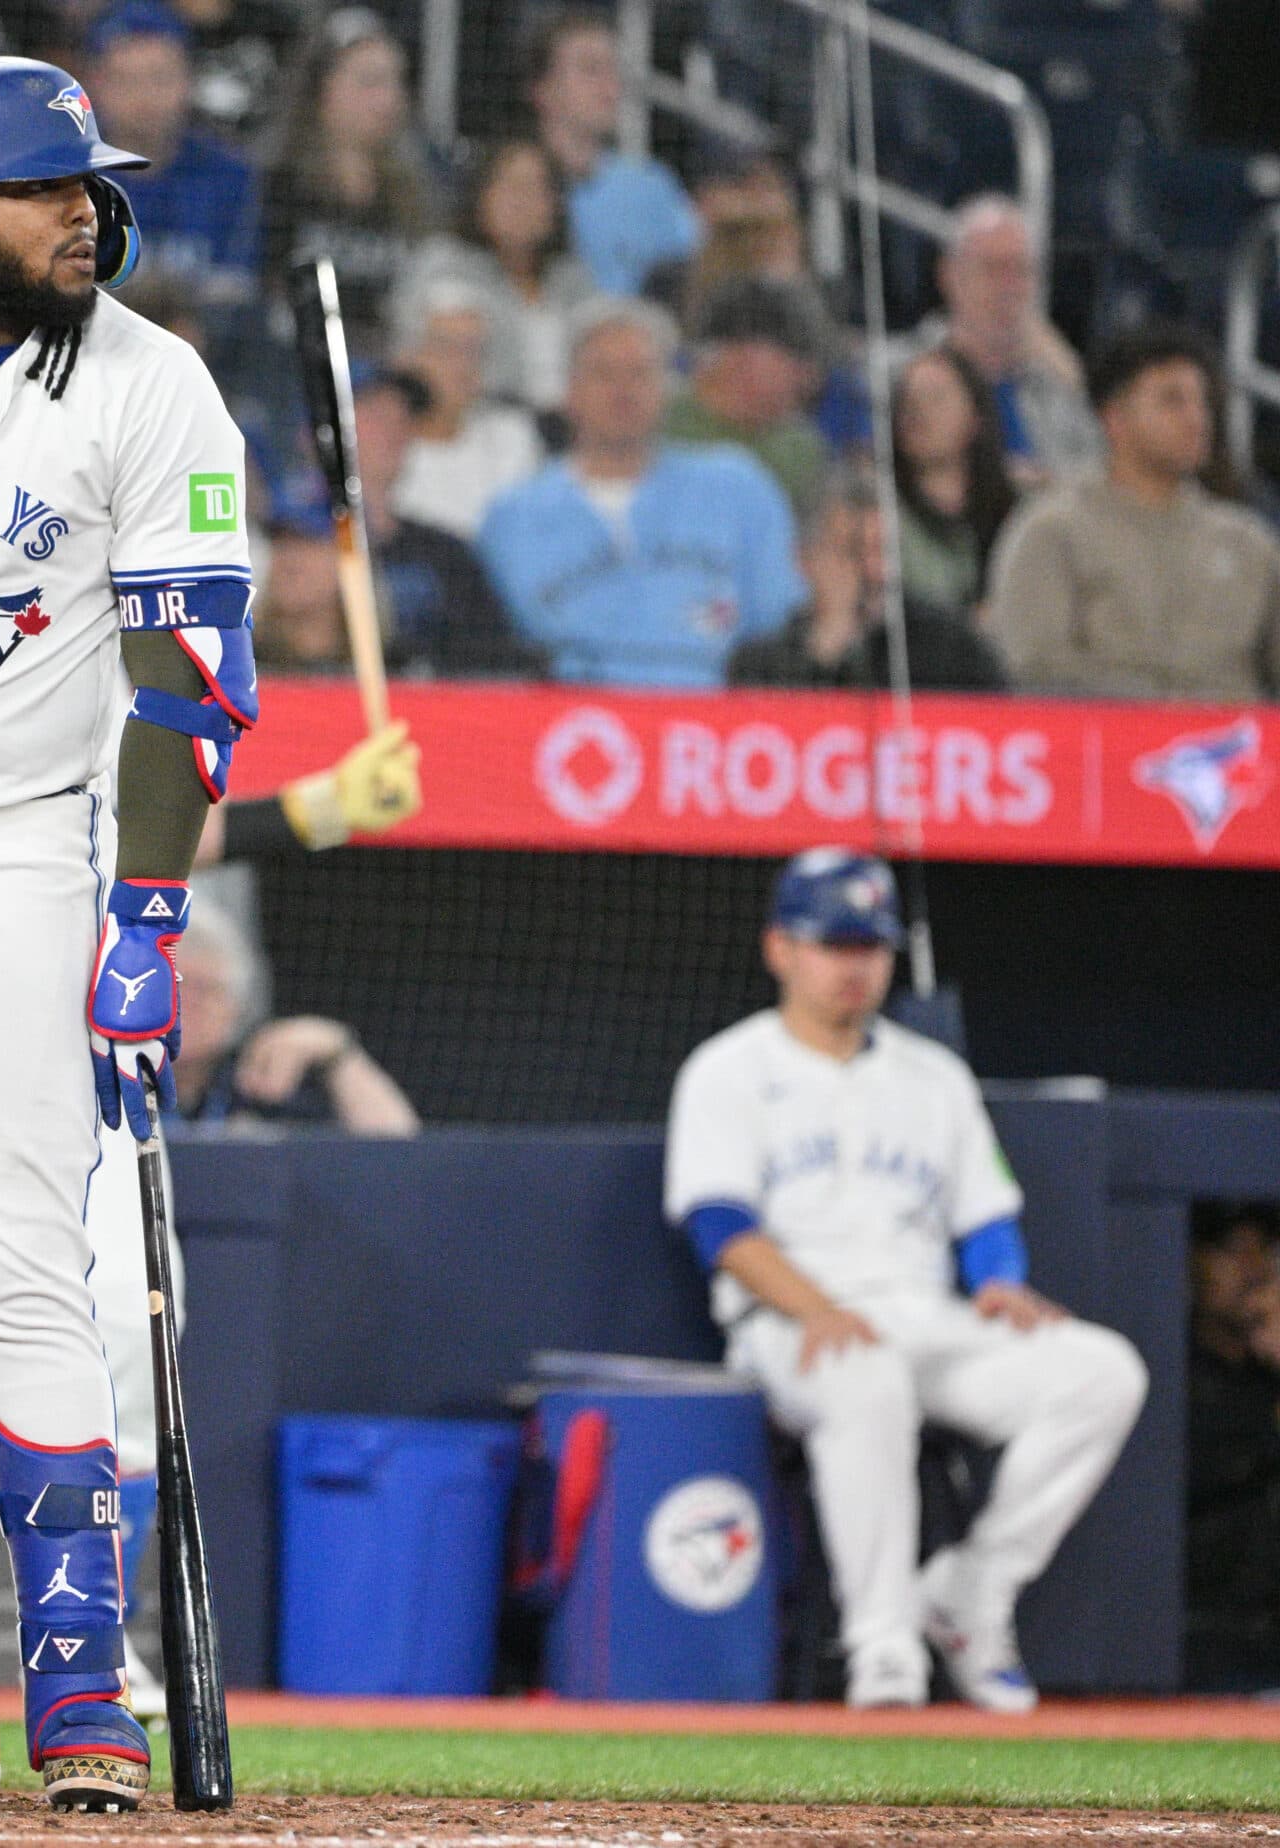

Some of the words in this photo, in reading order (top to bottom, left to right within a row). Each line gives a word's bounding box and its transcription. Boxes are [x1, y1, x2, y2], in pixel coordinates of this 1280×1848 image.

[195, 484, 234, 520] TD
[154, 591, 200, 626] JR.
[663, 722, 1053, 825] ROGERS
[93, 1490, 120, 1524] GU
